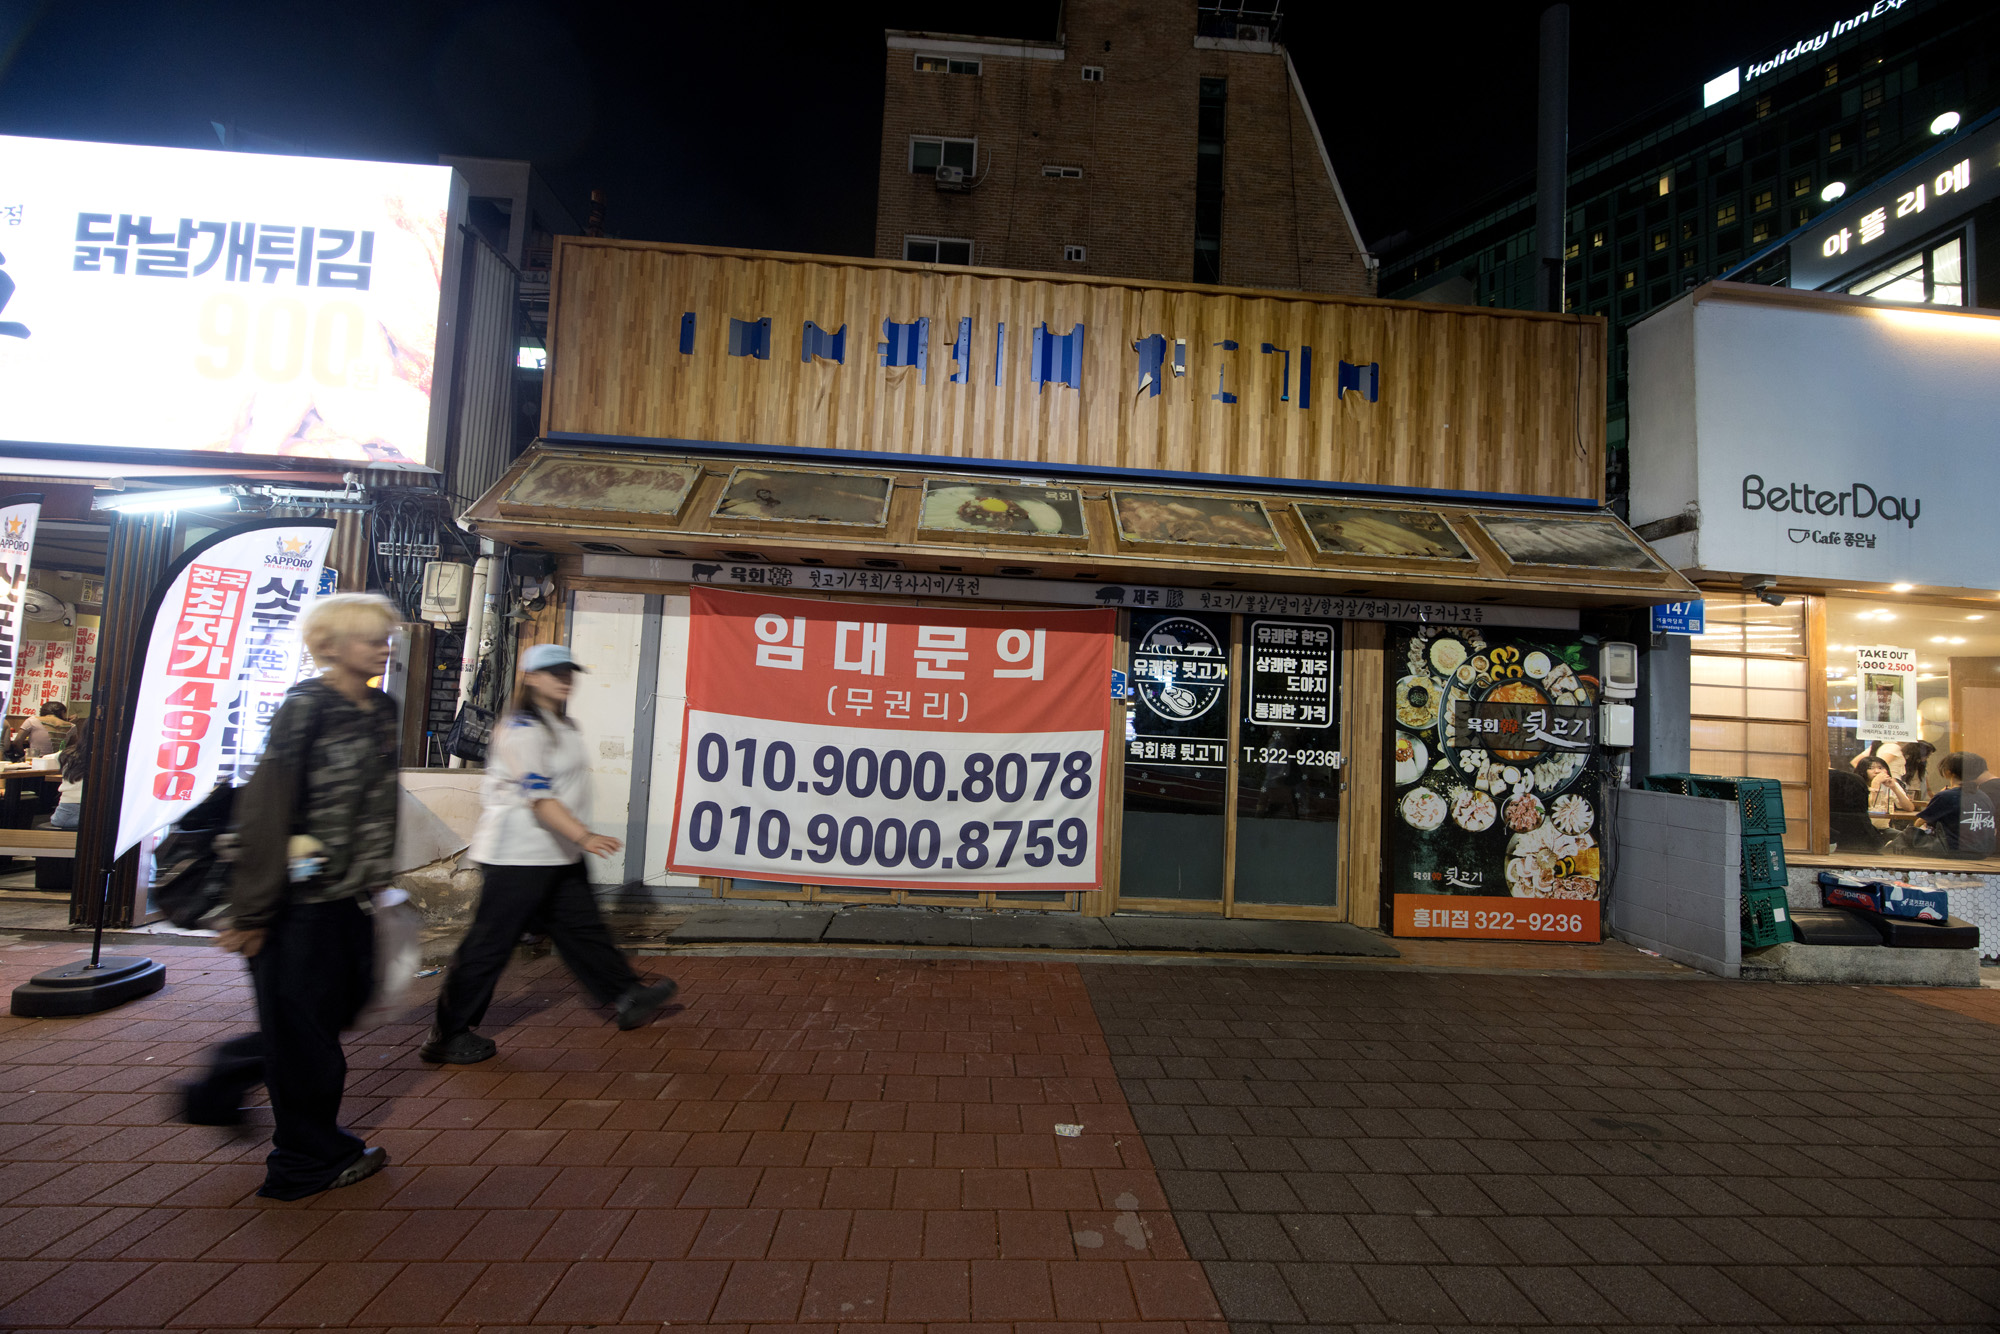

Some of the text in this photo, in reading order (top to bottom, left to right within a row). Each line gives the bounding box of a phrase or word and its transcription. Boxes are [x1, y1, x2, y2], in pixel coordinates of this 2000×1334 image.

[1744, 30, 1830, 82] Holiday
[1831, 10, 1869, 39] Inn
[72, 210, 377, 292] 닭날개튀김
[1742, 474, 1921, 529] BetterDay
[1811, 529, 1841, 545] Café
[264, 554, 313, 568] SAPPORO
[192, 567, 248, 588] 전국
[1133, 588, 1159, 606] 제주
[1666, 600, 1692, 615] 147
[171, 586, 240, 675] 최저가
[1257, 627, 1329, 647] 유쾌한 한우
[1859, 649, 1909, 660] TAKE OUT
[1133, 658, 1179, 678] 유쾌한
[1256, 656, 1328, 676] 상쾌한 제주
[1887, 662, 1915, 672] 2,500
[1110, 683, 1124, 695] -2
[1286, 675, 1327, 693] 도야지
[827, 685, 969, 723] (무권리)
[1255, 702, 1327, 722] 통쾌한 가격
[1522, 708, 1591, 749] 뒷고기
[1180, 743, 1224, 762] 뒷고기
[1243, 746, 1335, 767] T.322-9236
[696, 732, 1093, 803] 010.9000.8078
[688, 800, 1089, 871] 010.9000.8759
[1444, 866, 1483, 889] 뒷고기
[1834, 888, 1868, 902] coupang
[1413, 908, 1583, 933] 홍대점 322-9236
